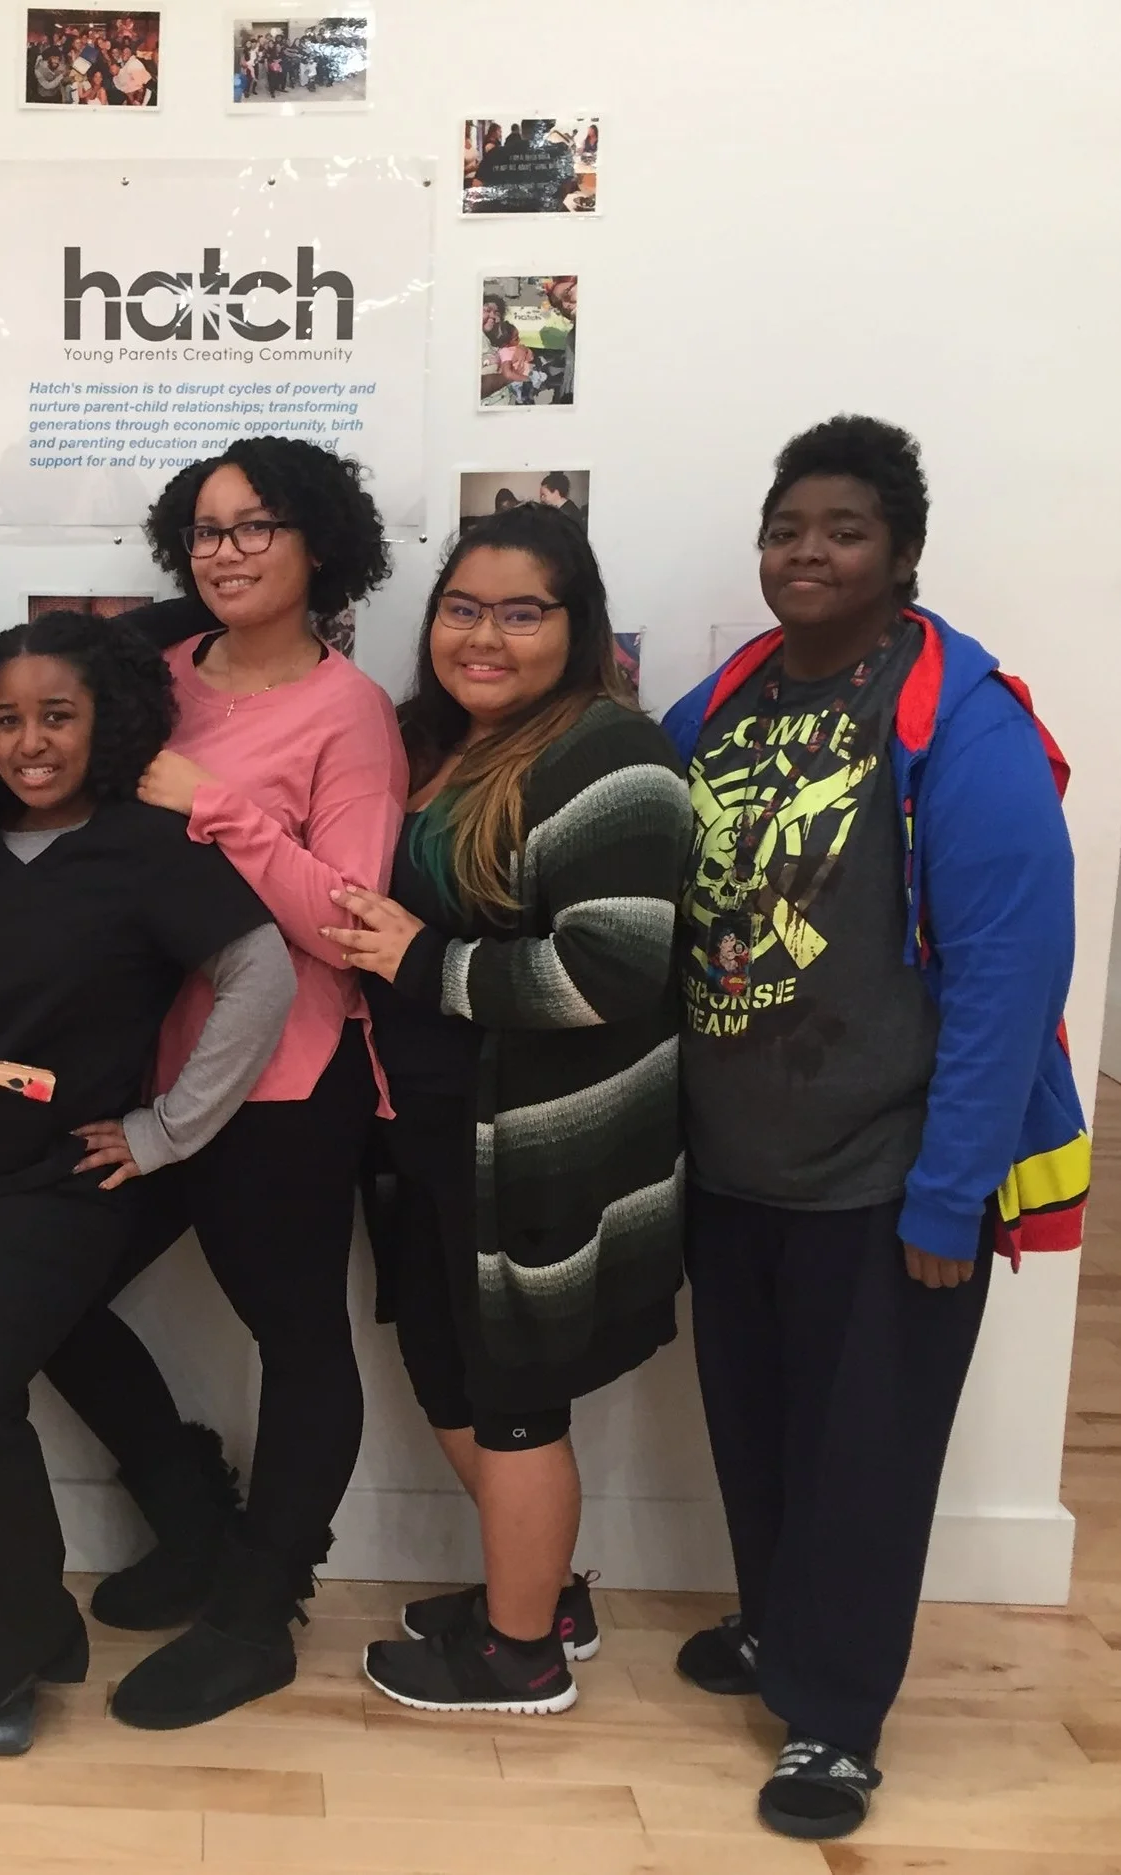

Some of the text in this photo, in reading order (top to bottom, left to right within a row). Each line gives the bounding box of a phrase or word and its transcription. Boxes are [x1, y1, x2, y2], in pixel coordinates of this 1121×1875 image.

[64, 246, 354, 342] hatch
[64, 347, 353, 363] Young Parents Creating Community
[29, 382, 377, 398] Hatch's mission is to disrupt cycles of poverty and
[29, 400, 359, 415] nurture parent-child relationships; transforming
[29, 419, 364, 433] generations through economic opportunity, birth
[29, 437, 229, 451] and parenting education and
[324, 437, 340, 449] of
[29, 455, 198, 469] support for and by youn
